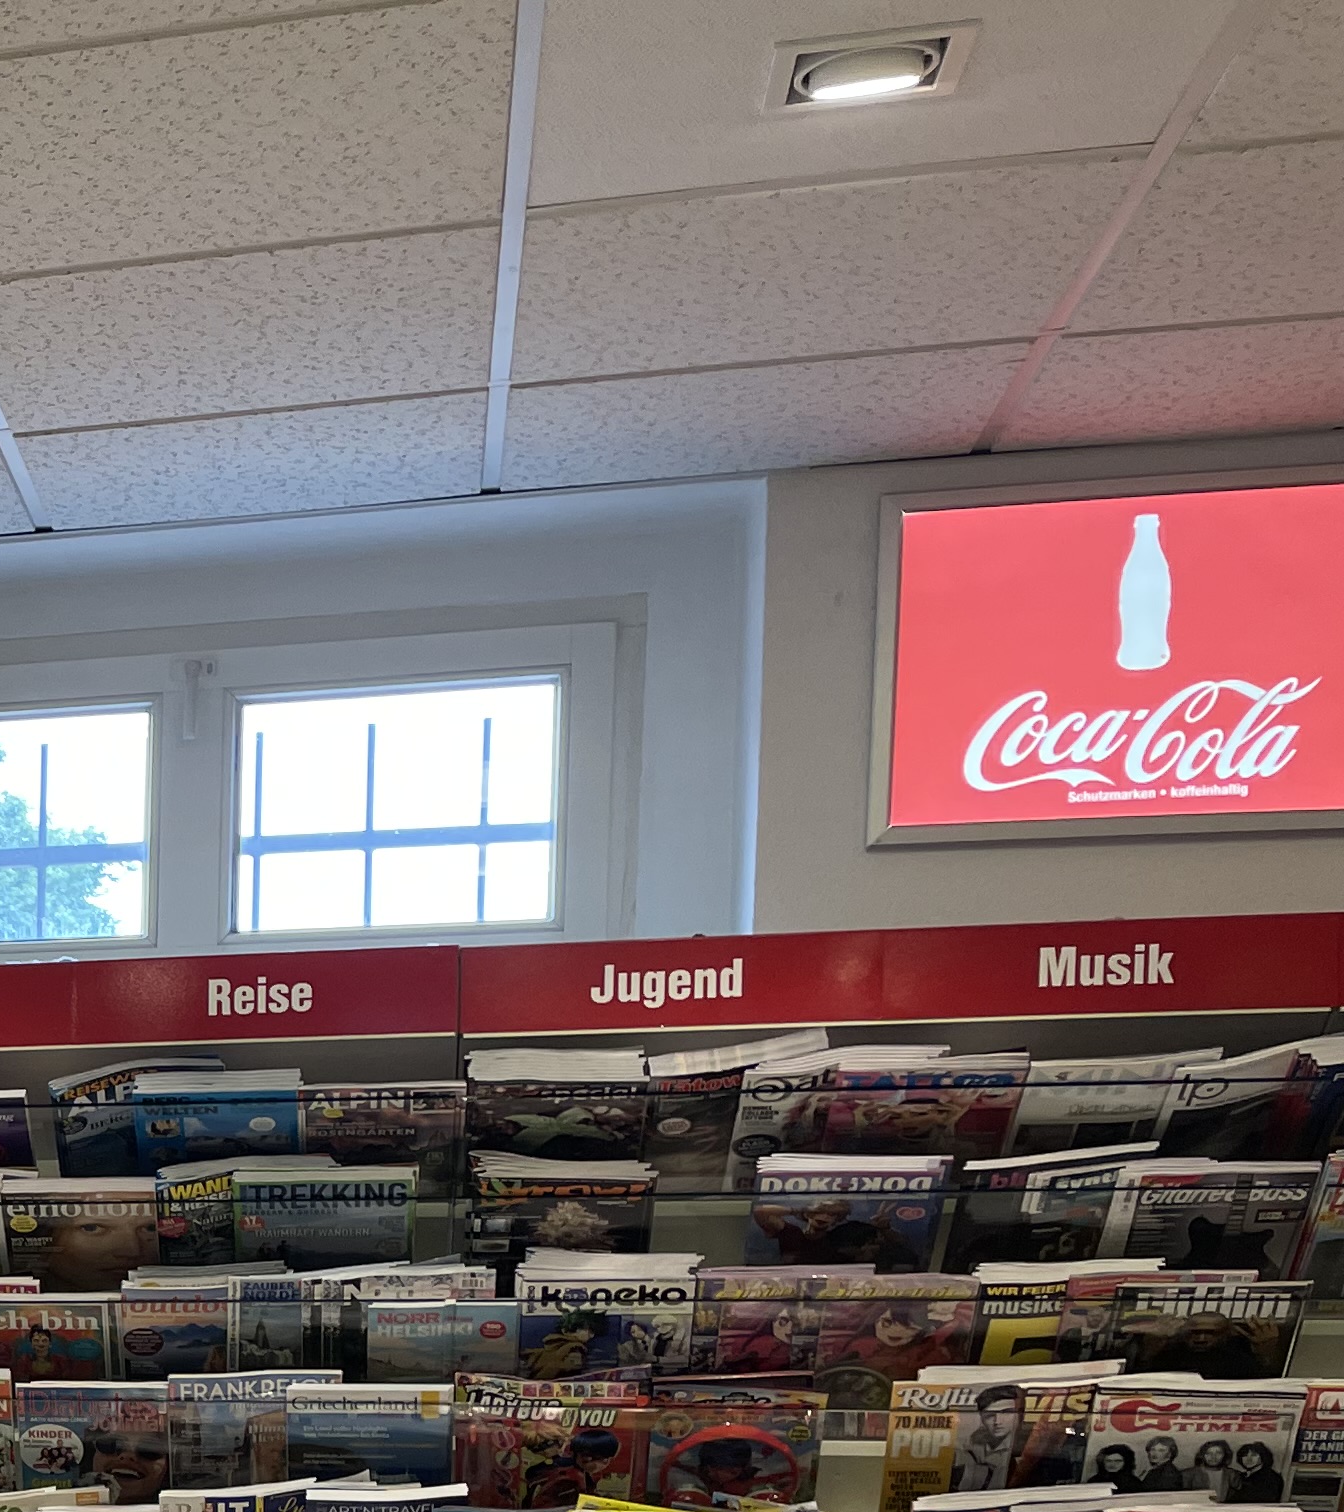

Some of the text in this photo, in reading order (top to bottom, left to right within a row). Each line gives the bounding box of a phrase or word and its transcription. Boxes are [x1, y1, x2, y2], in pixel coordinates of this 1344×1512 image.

[963, 676, 1323, 792] Coca-Cola
[1068, 784, 1249, 803] Schutzmarken koffeinhaltig
[590, 958, 744, 1008] Jugend
[1038, 944, 1174, 988] Musik
[208, 976, 313, 1016] Reise
[253, 1182, 408, 1211] TREKKING
[40, 1309, 100, 1332] bin
[291, 1396, 418, 1414] Griechenland
